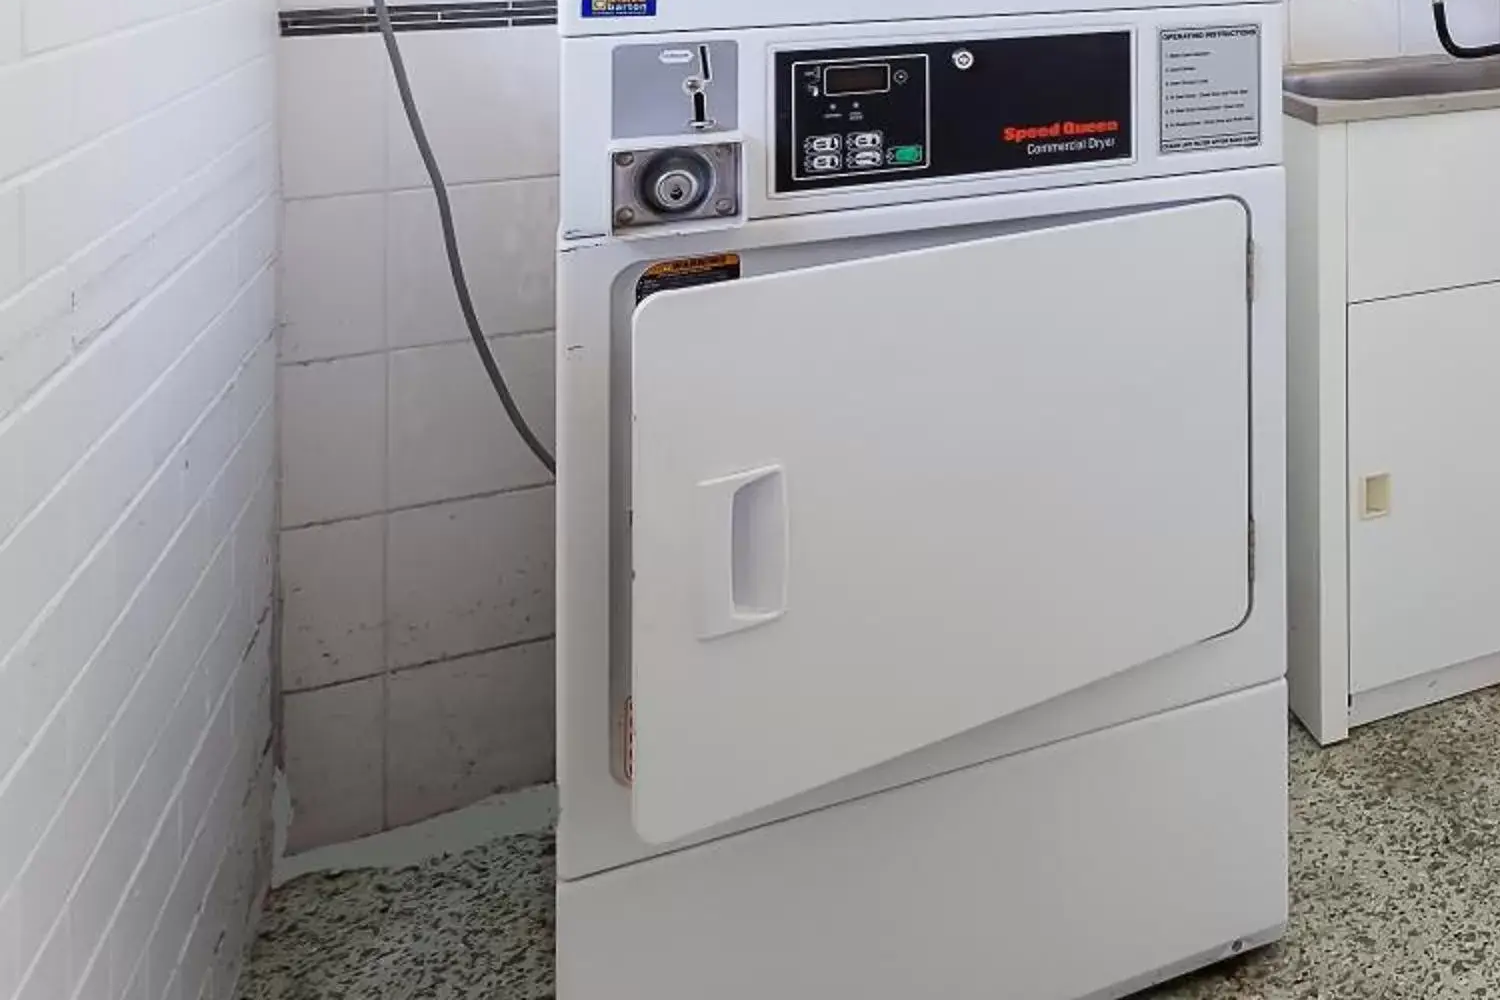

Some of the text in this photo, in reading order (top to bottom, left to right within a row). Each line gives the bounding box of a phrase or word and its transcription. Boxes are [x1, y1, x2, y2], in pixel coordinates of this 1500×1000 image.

[1161, 31, 1204, 41] OPERATING
[1003, 120, 1118, 142] Speed Queen
[1027, 136, 1116, 155] Commercial Dryer
